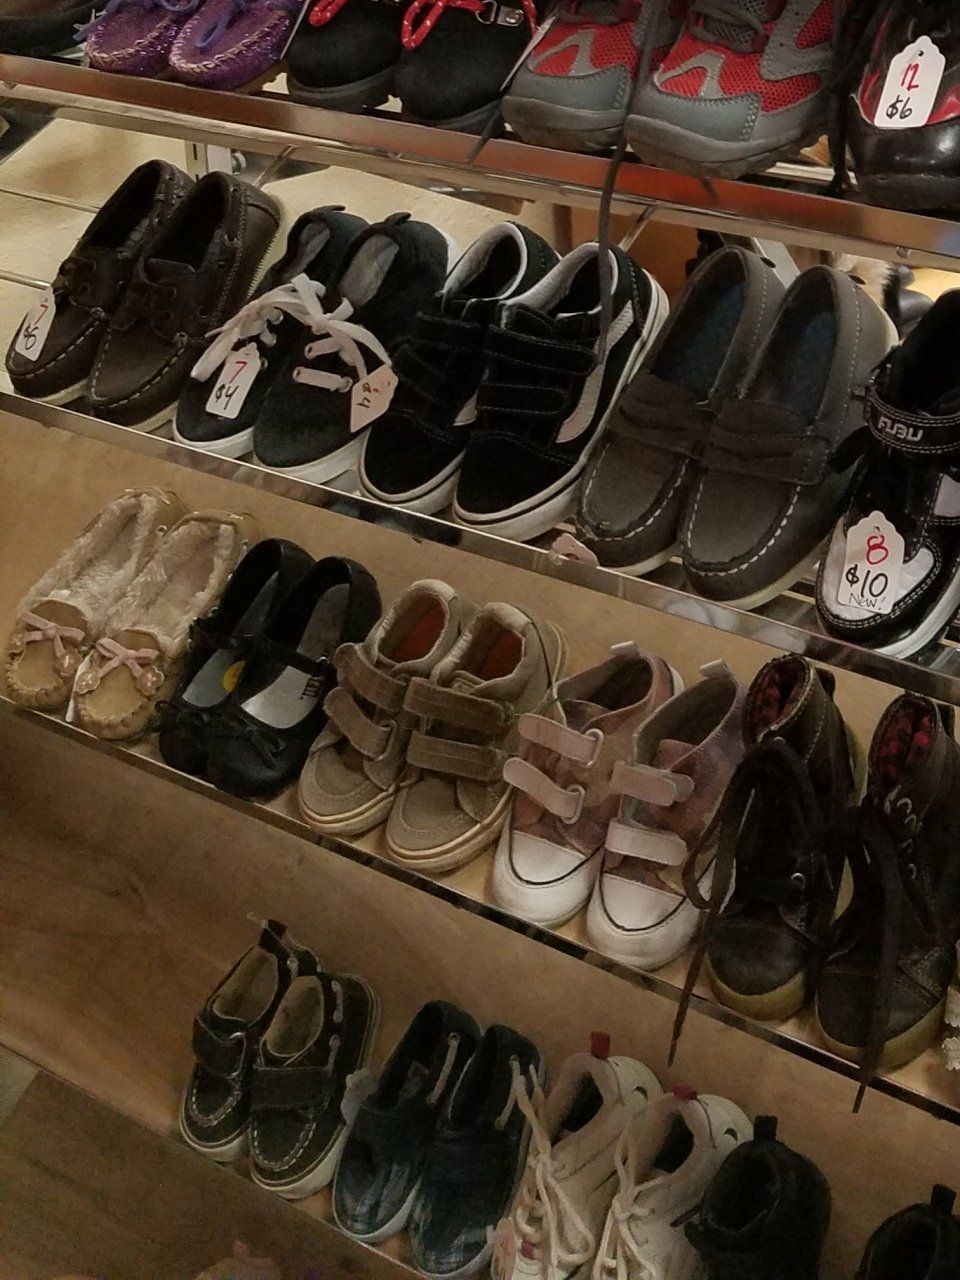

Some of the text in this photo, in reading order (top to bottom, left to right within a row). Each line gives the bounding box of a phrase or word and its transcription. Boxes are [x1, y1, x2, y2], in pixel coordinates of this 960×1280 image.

[901, 62, 920, 92] 12
[885, 94, 913, 120] $6
[33, 303, 49, 326] 7
[229, 360, 248, 384] 7
[215, 383, 240, 411] $4
[877, 416, 924, 442] FUBU
[866, 534, 889, 565] 8
[845, 563, 889, 598] $10
